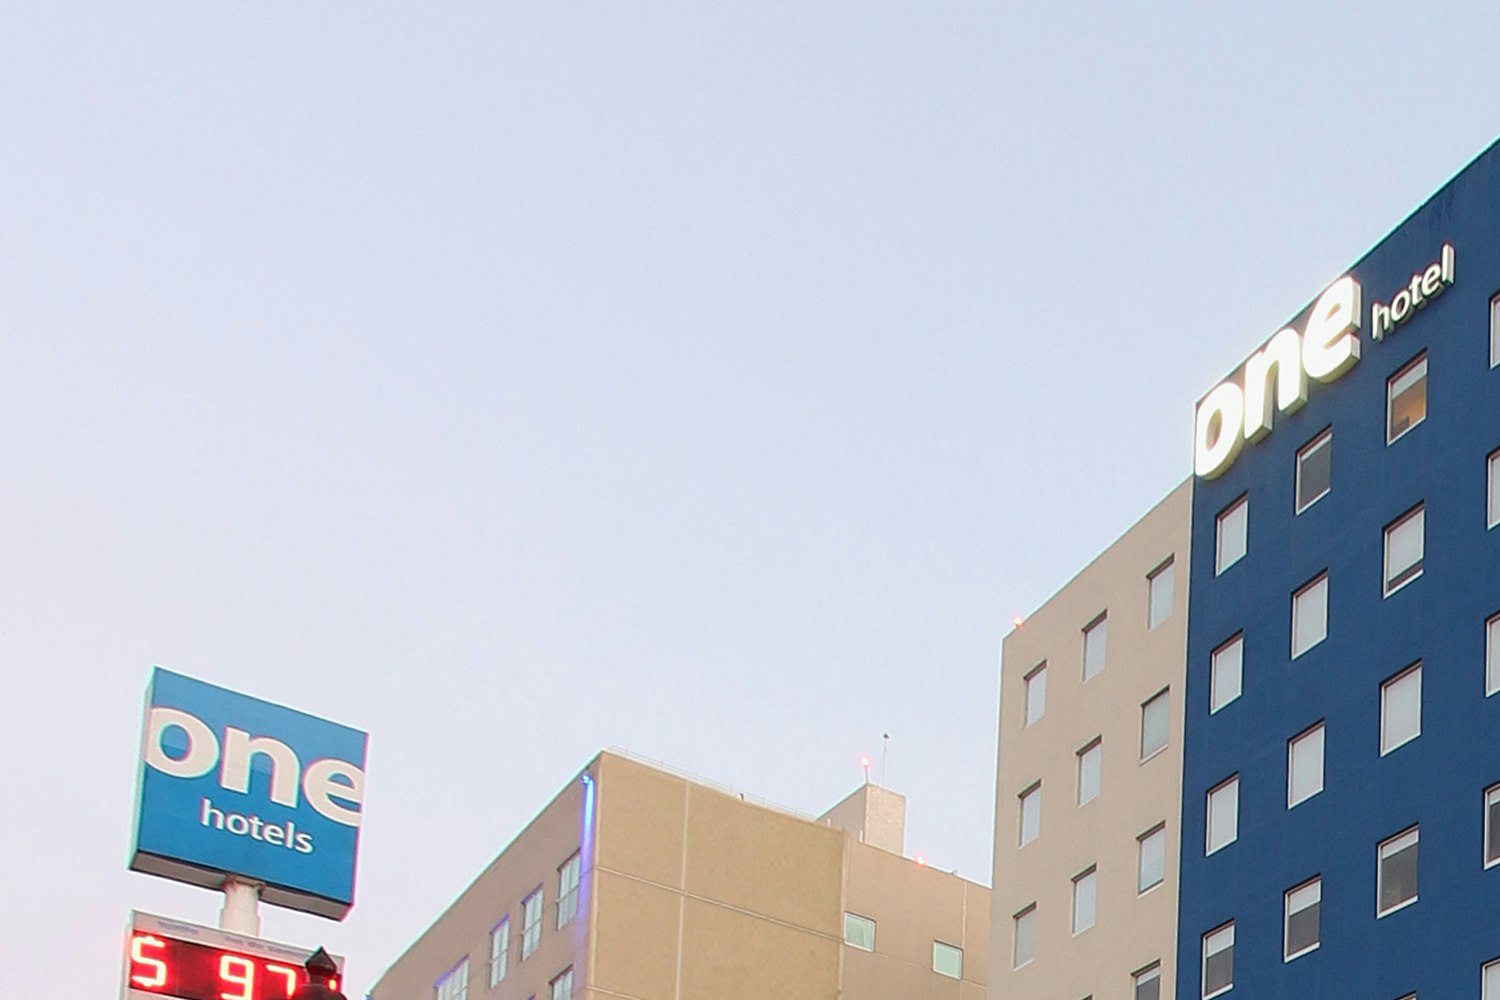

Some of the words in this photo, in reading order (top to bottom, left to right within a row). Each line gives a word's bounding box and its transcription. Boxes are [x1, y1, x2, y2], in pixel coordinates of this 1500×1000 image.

[1194, 274, 1361, 481] one
[1371, 240, 1455, 345] hotel
[144, 705, 364, 828] one
[201, 796, 314, 855] hotels
